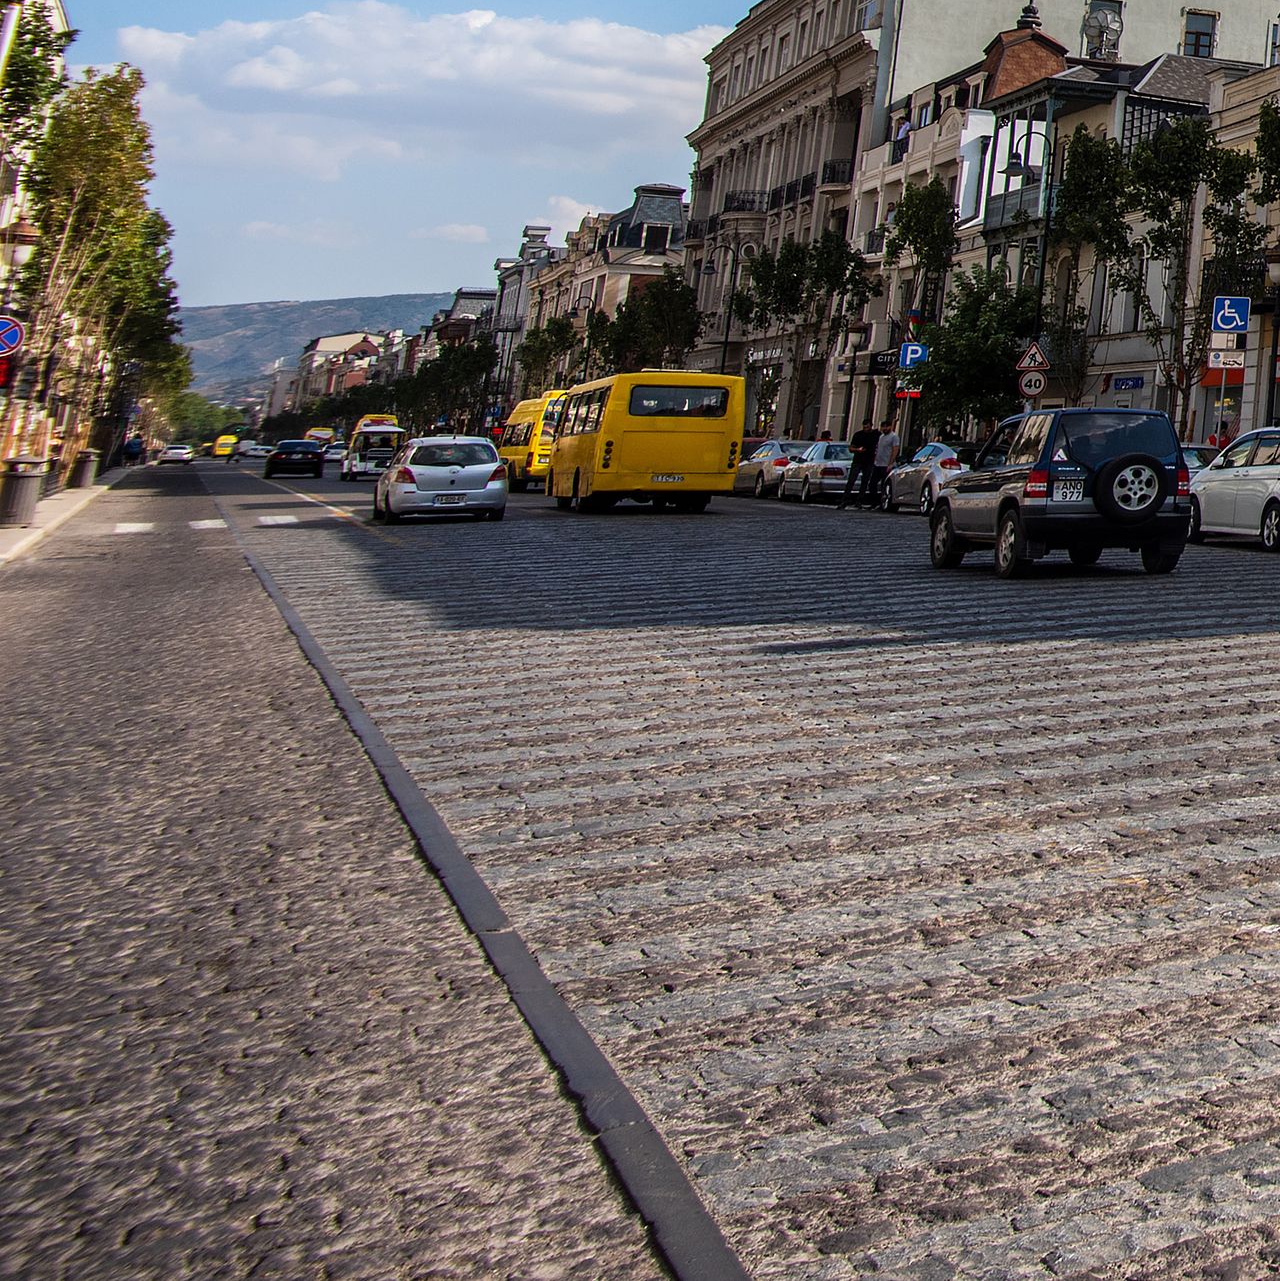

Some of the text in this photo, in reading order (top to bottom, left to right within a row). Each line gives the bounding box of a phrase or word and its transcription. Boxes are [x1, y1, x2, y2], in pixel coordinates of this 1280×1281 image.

[877, 355, 897, 363] CITY
[906, 345, 923, 366] P
[1024, 379, 1042, 389] 40
[1061, 491, 1082, 500] 977
